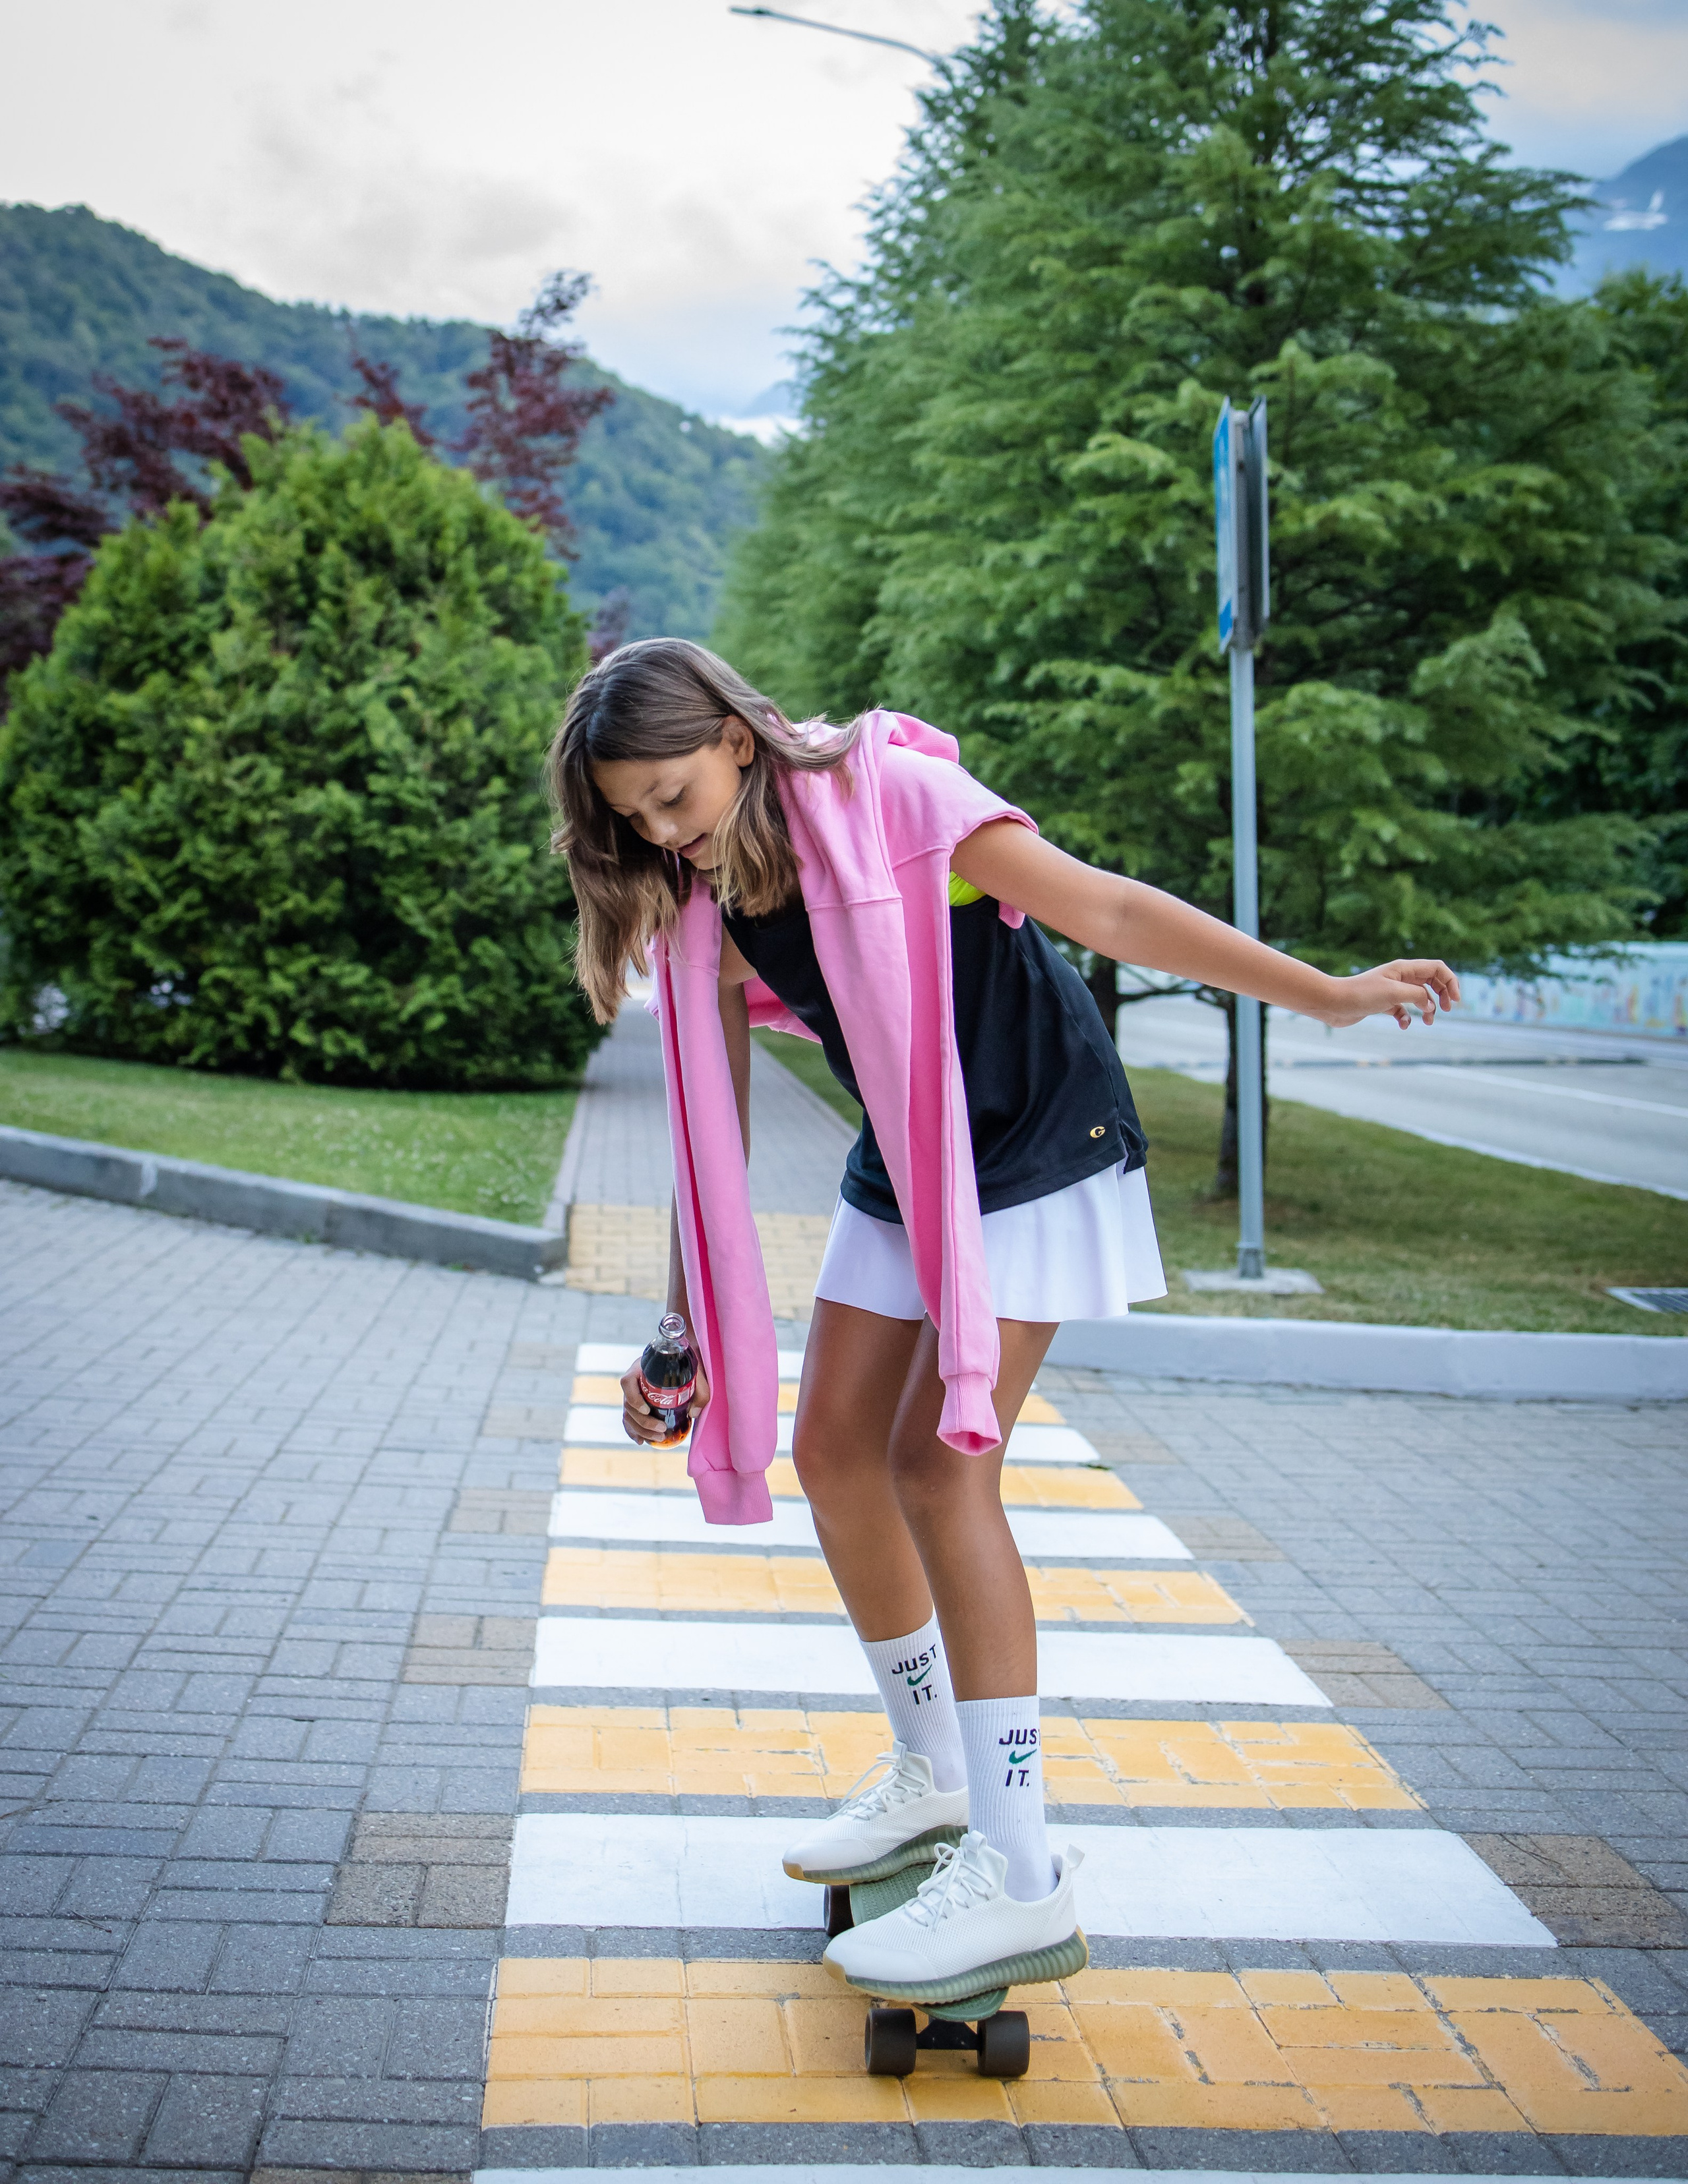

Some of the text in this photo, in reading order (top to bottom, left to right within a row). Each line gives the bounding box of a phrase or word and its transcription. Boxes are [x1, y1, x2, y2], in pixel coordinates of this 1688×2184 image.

[891, 1643, 936, 1674] JUST
[913, 1684, 937, 1705] IT.
[1006, 1769, 1030, 1787] IT.
